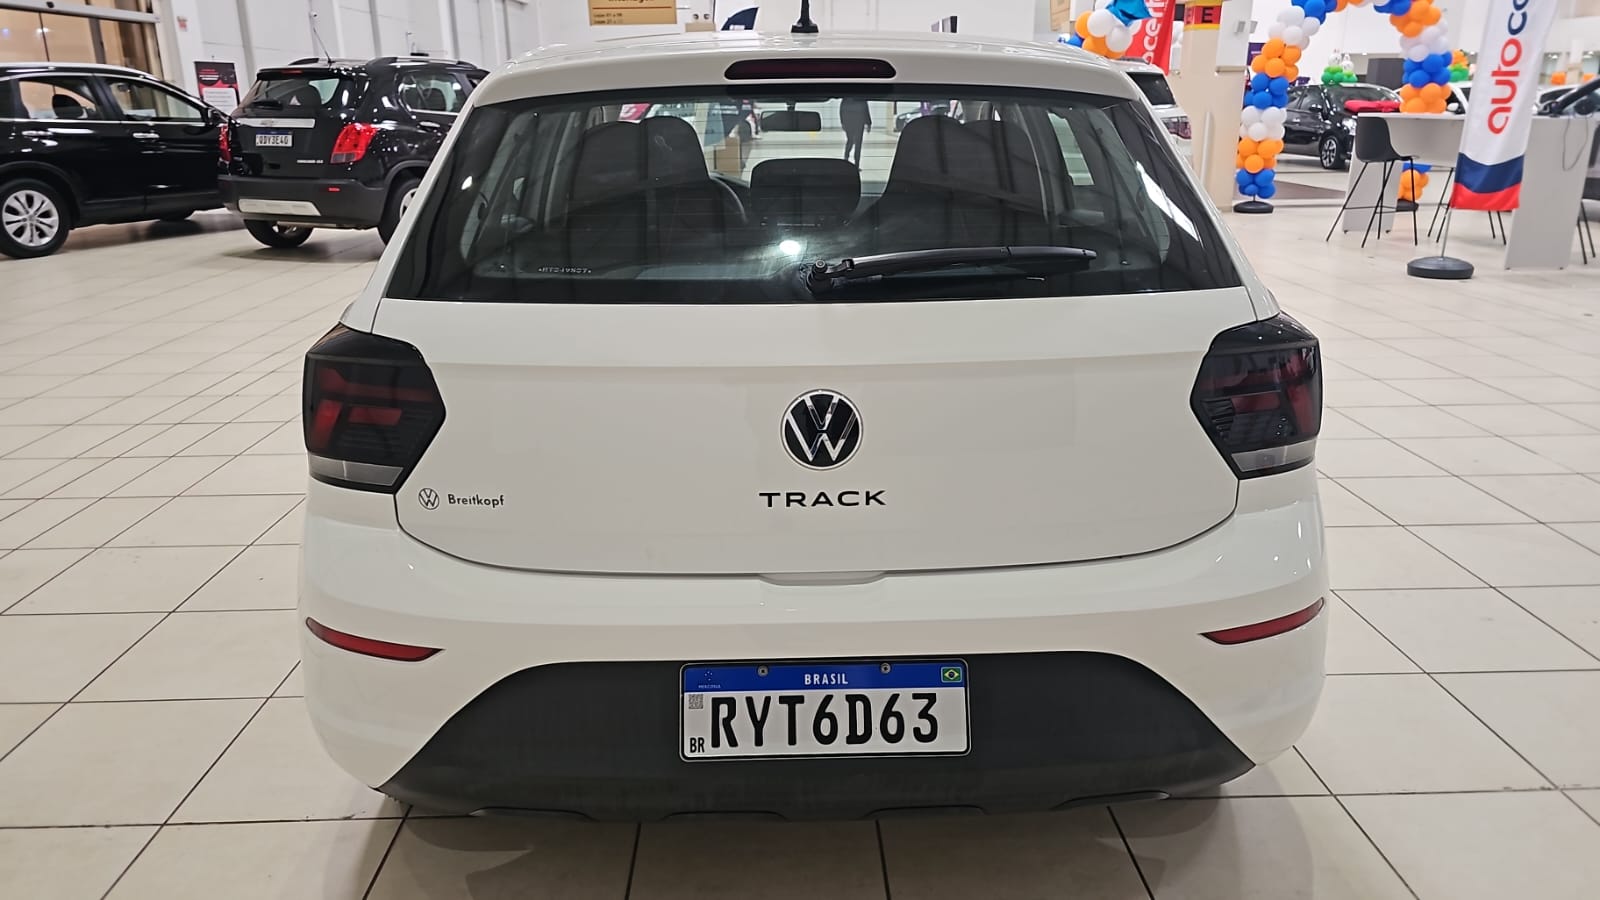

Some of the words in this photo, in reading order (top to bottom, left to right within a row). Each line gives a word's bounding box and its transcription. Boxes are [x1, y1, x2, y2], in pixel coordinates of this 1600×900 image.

[447, 493, 505, 509] Breitkopf
[758, 490, 887, 507] TRACK
[804, 673, 849, 685] BRASIL
[710, 692, 939, 748] RYT6D63
[689, 737, 705, 753] BR
